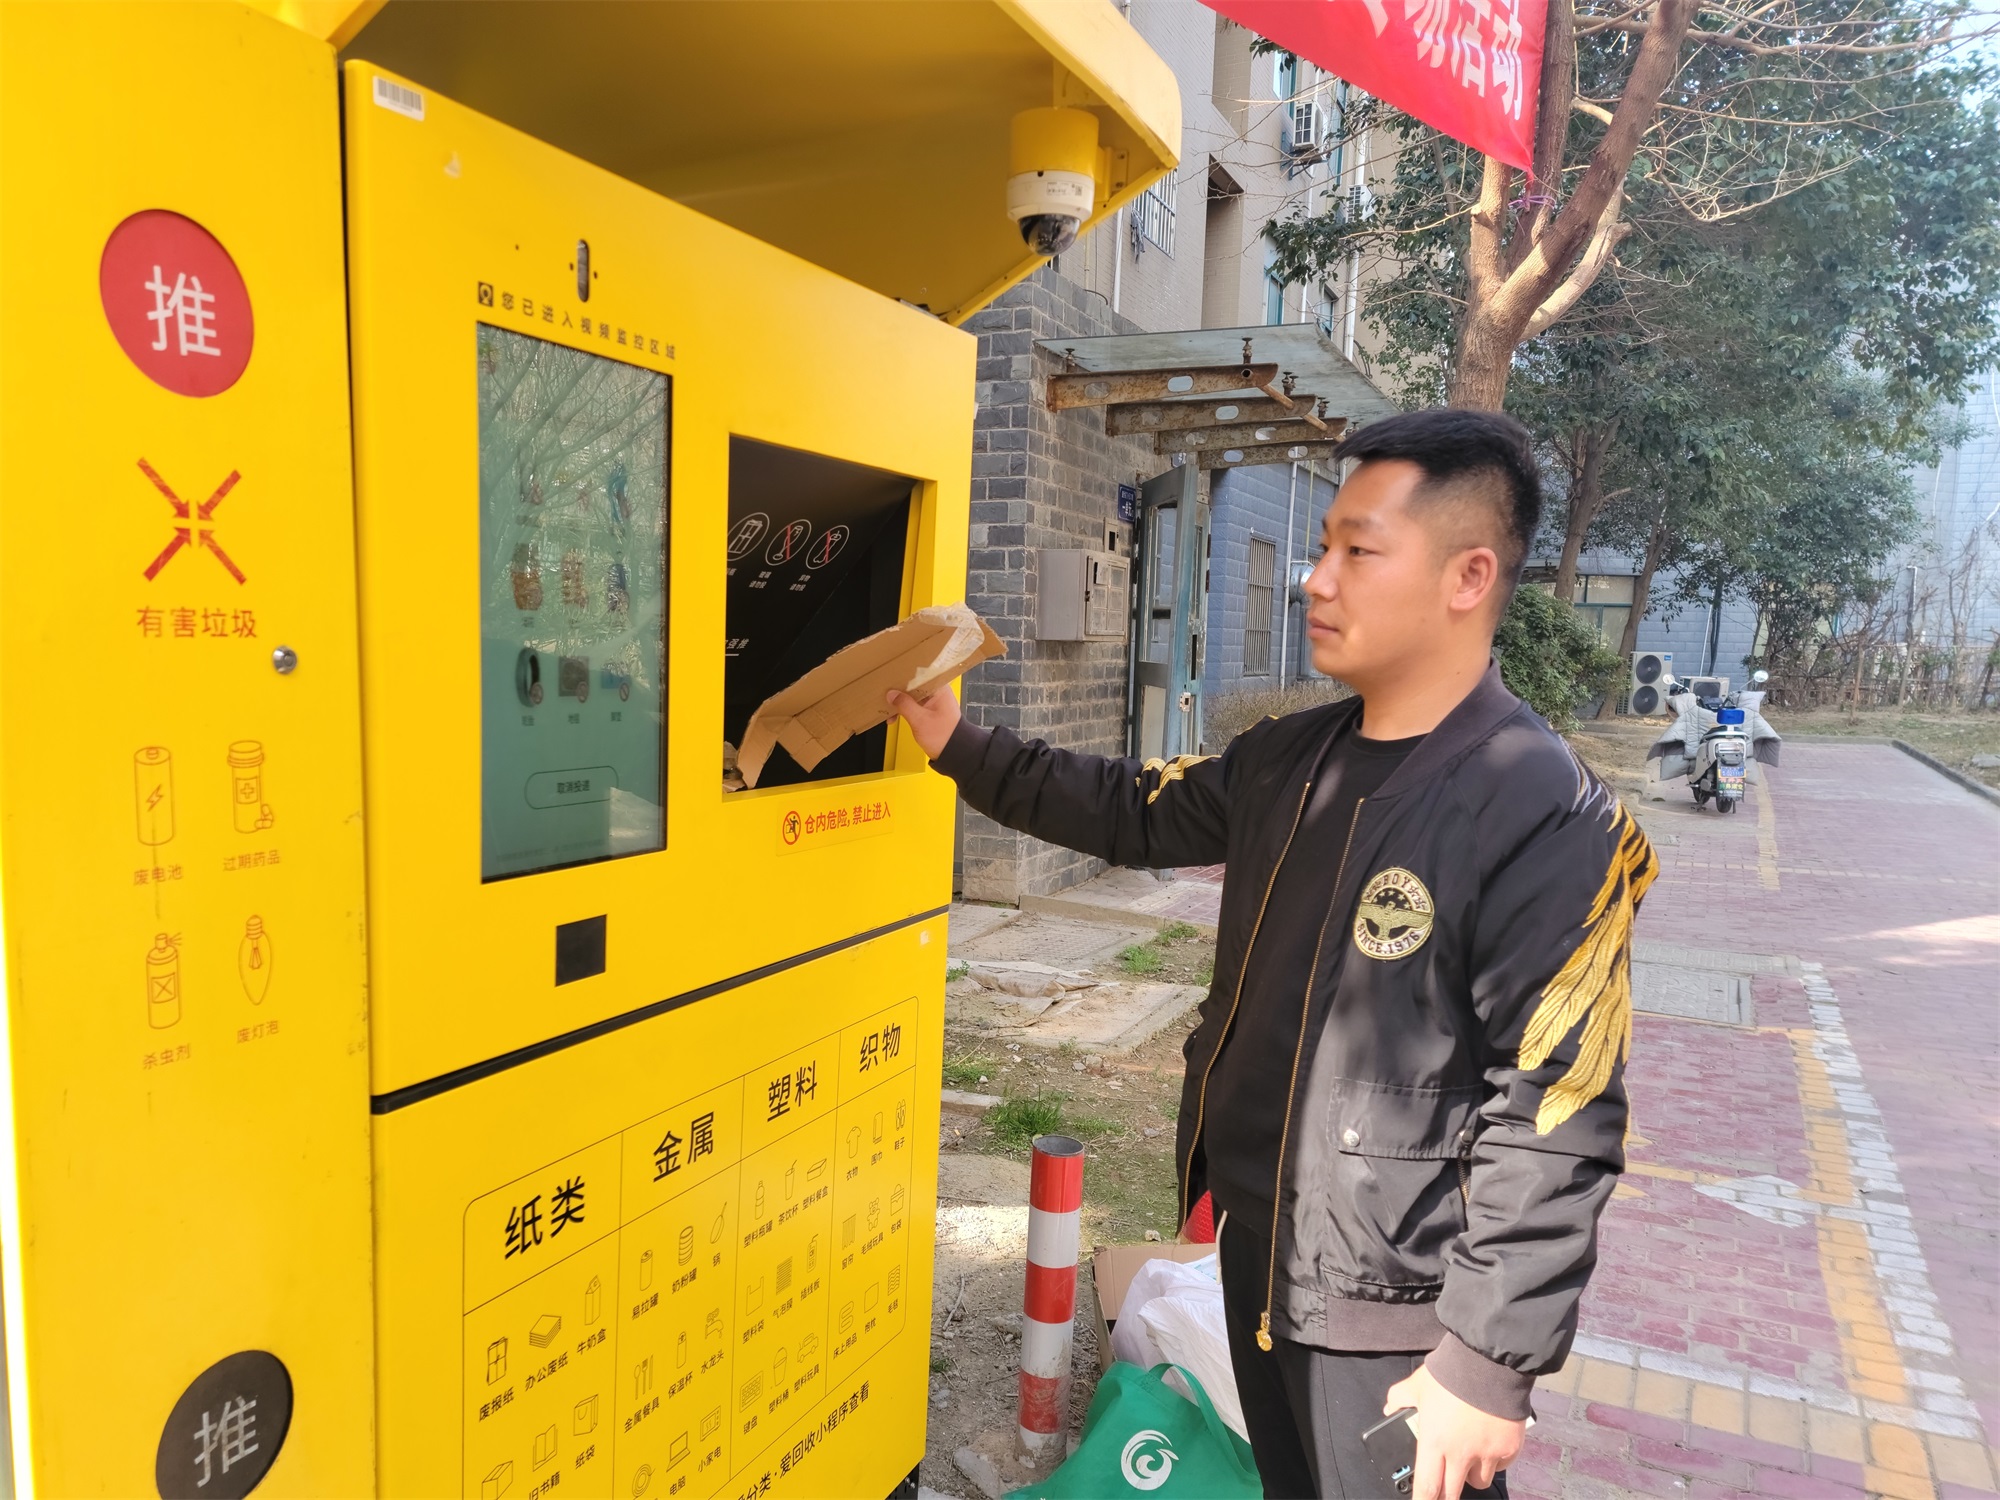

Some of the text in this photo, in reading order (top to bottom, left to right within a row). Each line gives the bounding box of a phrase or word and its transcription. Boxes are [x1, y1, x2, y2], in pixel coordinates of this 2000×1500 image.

[144, 265, 221, 356] 推
[501, 291, 676, 360] 您已进入视频监控区域
[136, 605, 257, 638] 有害垃圾
[804, 801, 891, 834] 仓内危险，禁止进入
[222, 849, 281, 872] 过期药品
[133, 864, 183, 886] 废电池
[236, 1020, 280, 1044] 废灯泡
[142, 1044, 191, 1071] 杀虫剂
[859, 1022, 901, 1074] 织物
[767, 1060, 818, 1123] 塑料
[652, 1111, 715, 1183] 金属
[894, 1137, 905, 1151] 鞋子
[871, 1151, 883, 1166] 围巾
[846, 1166, 858, 1181] 衣物
[802, 1185, 828, 1210] 塑料餐盒
[503, 1176, 586, 1260] 纸类
[778, 1203, 799, 1225] 茶饮杯
[891, 1219, 902, 1234] 包袋
[744, 1220, 773, 1248] 塑料瓶罐
[861, 1232, 884, 1255] 毛绒玩具
[713, 1252, 721, 1268] 锅
[842, 1253, 854, 1270] 窗帘
[672, 1267, 697, 1294] 奶粉罐
[800, 1278, 820, 1301] 插线板
[632, 1292, 659, 1320] 易拉罐
[772, 1298, 793, 1318] 气泡膜
[888, 1298, 899, 1314] 毛毯
[743, 1319, 765, 1344] 塑料袋
[864, 1317, 877, 1334] 抱枕
[576, 1328, 607, 1355] 牛奶盒
[833, 1332, 857, 1360] 床上用品
[524, 1351, 569, 1392] 办公废纸
[701, 1349, 725, 1374] 水龙头
[668, 1371, 693, 1399] 保温杯
[794, 1363, 820, 1393] 塑料玩具
[479, 1386, 515, 1422] 废报纸
[768, 1389, 789, 1414] 塑料桶
[624, 1396, 660, 1433] 金属餐具
[743, 1415, 758, 1435] 键盘
[193, 1395, 259, 1488] 推
[575, 1445, 596, 1470] 纸袋
[698, 1446, 721, 1473] 小家电
[669, 1475, 686, 1496] 电脑
